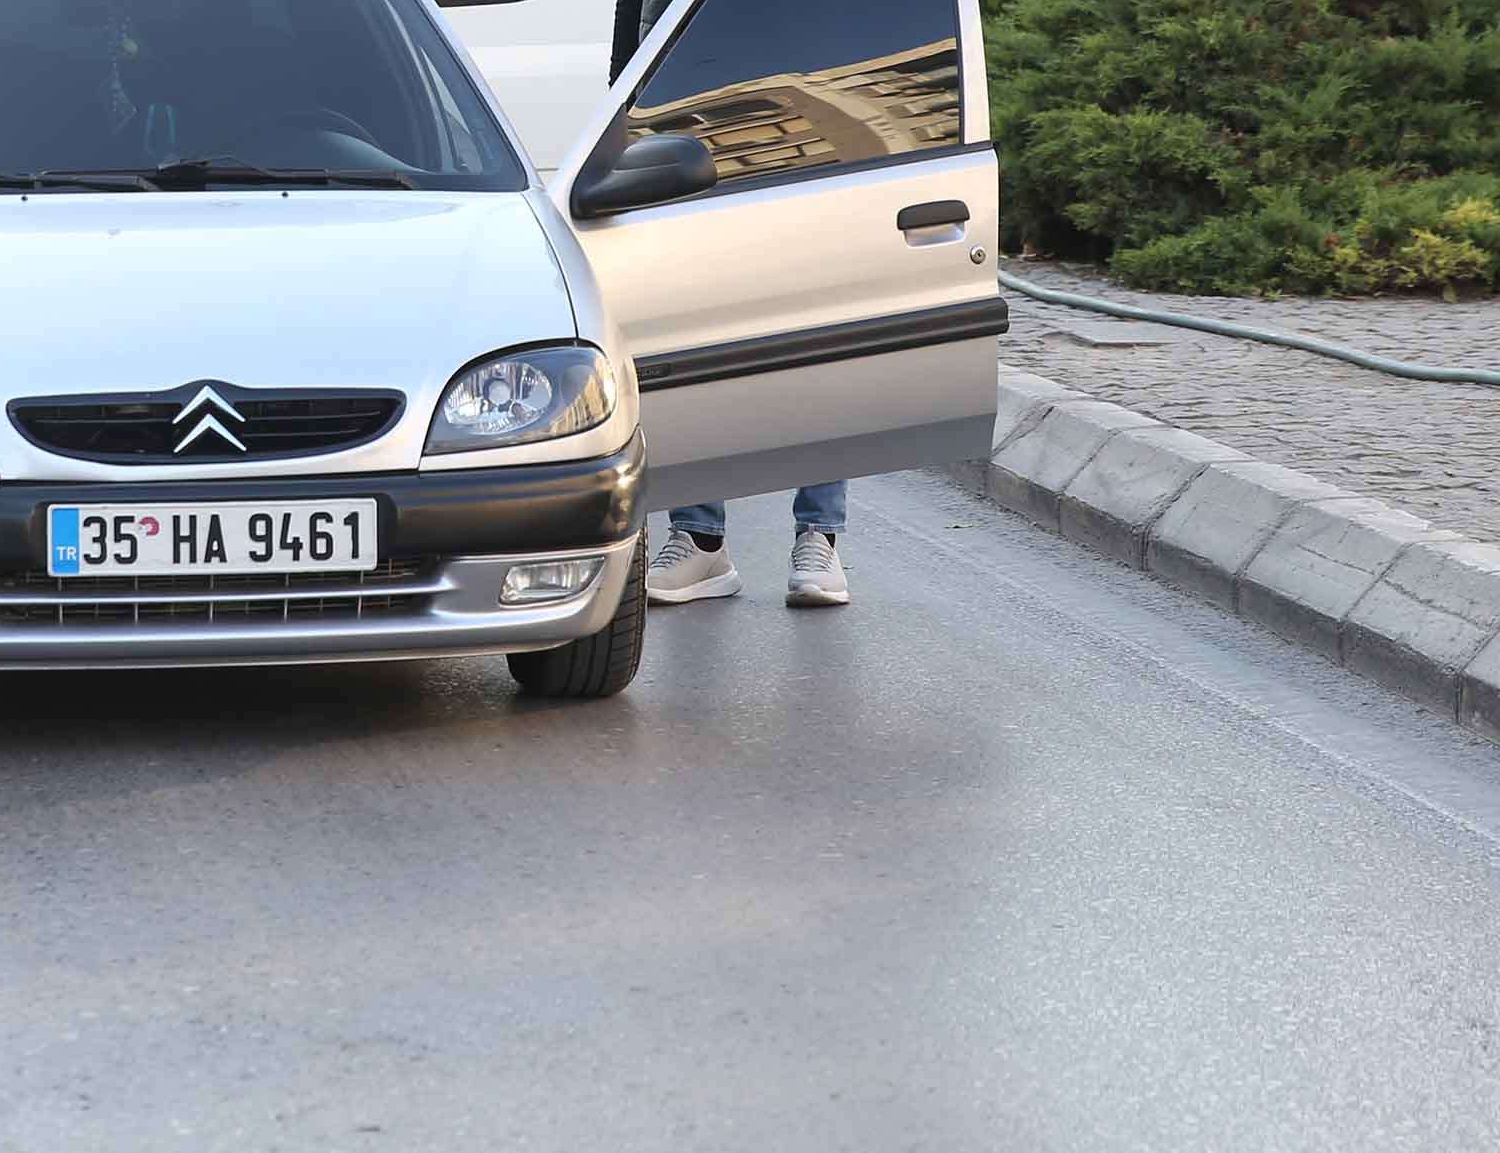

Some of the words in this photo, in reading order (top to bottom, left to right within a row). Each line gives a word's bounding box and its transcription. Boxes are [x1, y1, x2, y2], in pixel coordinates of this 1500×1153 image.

[57, 547, 77, 561] TR
[83, 515, 138, 565] 35
[172, 514, 228, 564] HA
[249, 511, 360, 563] 9461
